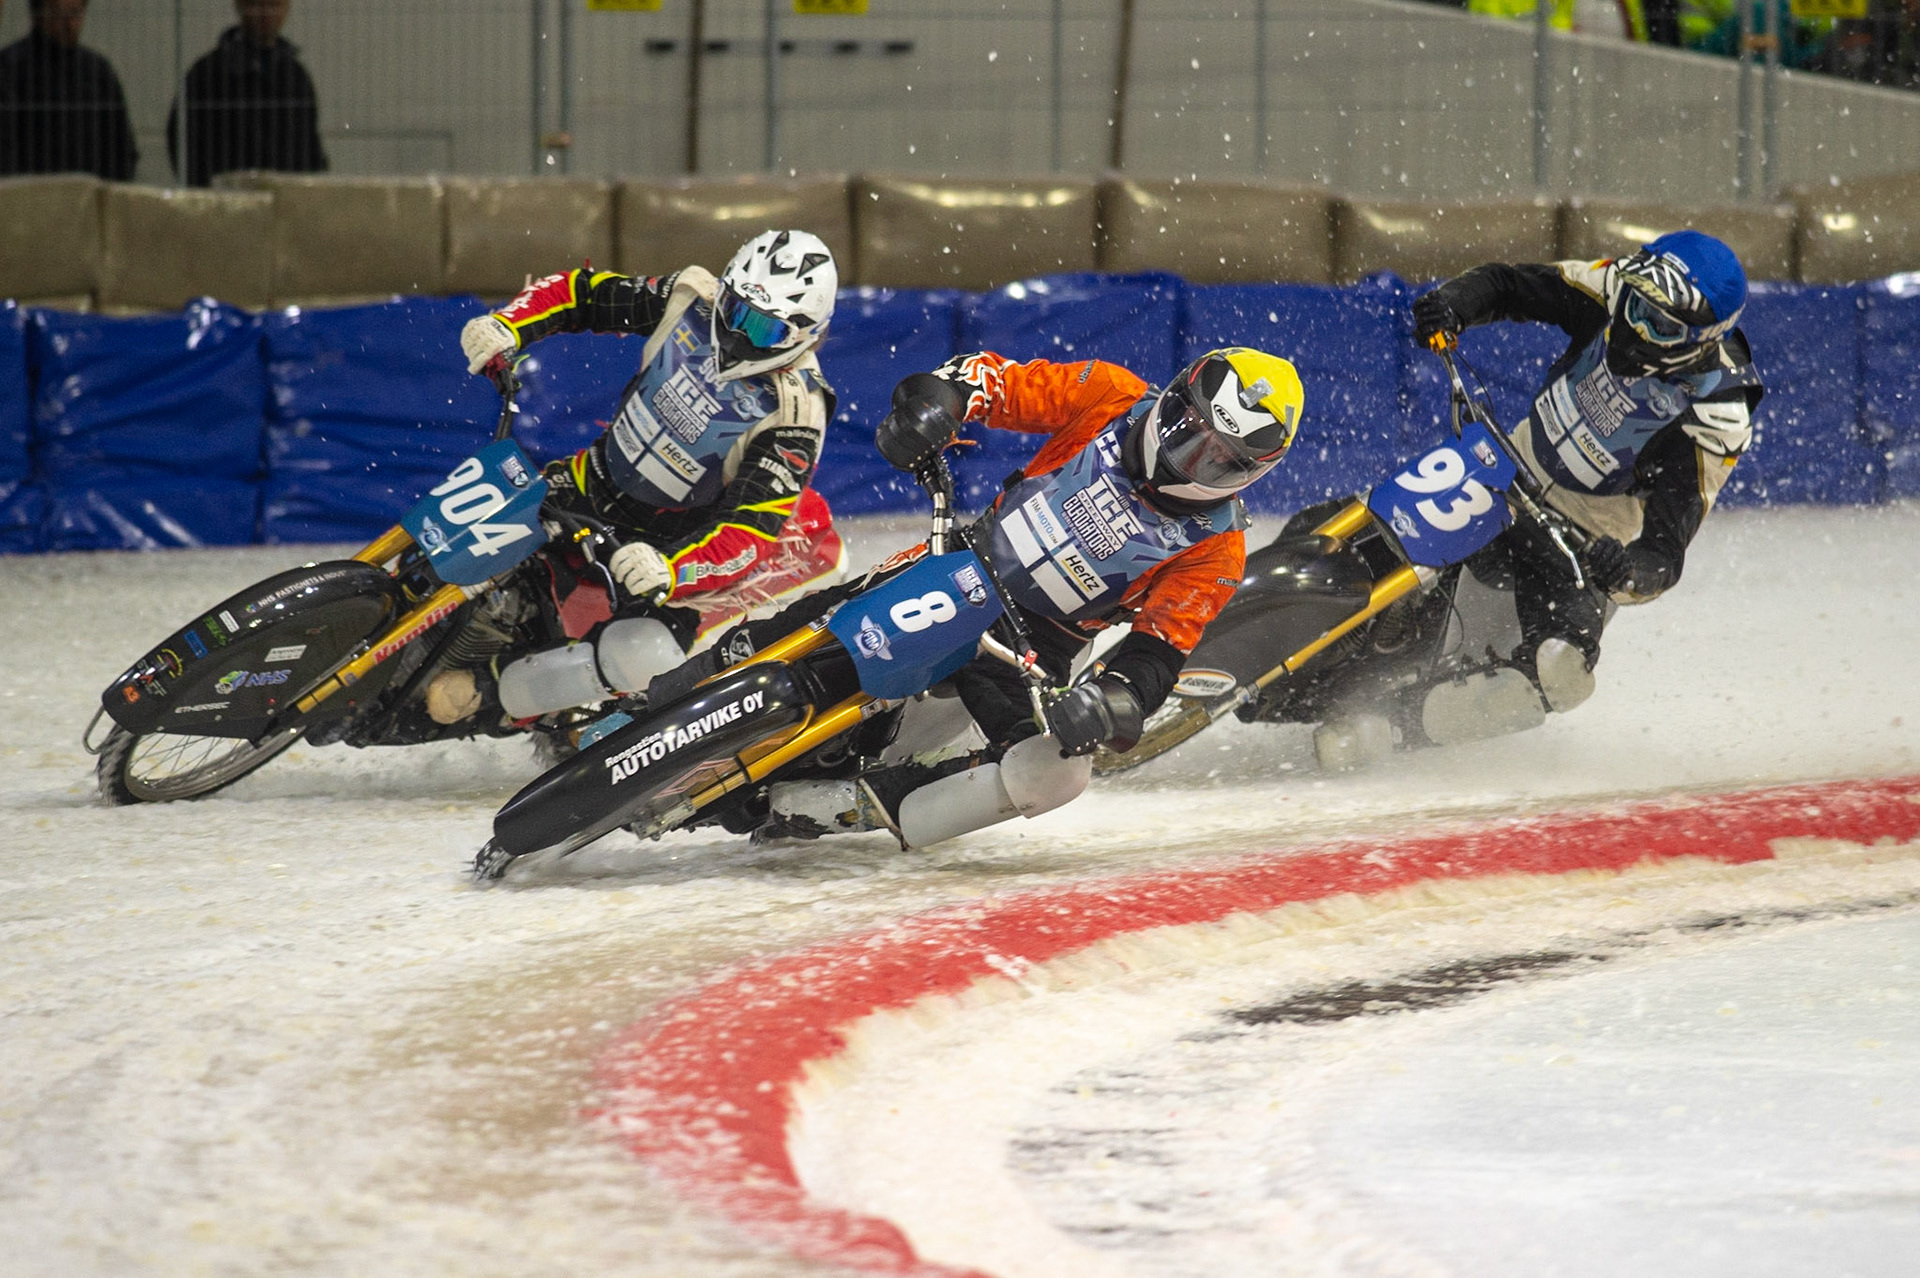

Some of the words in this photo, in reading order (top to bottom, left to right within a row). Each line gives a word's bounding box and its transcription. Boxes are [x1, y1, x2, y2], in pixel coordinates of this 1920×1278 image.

[666, 369, 718, 424] ICE
[1587, 363, 1633, 420] ICE
[662, 441, 698, 475] Hertz
[1579, 432, 1611, 466] Hertz
[429, 457, 533, 557] 904
[1084, 476, 1141, 544] ICE
[1394, 448, 1493, 531] 93
[1078, 491, 1119, 547] SPEEDWAY
[1162, 522, 1179, 539] FIM
[1064, 553, 1100, 591] Hertz
[890, 591, 957, 633] 8
[864, 632, 880, 650] FIM
[244, 669, 291, 686] NHS
[612, 702, 742, 785] AUTOTARVIKE
[743, 691, 764, 713] OY
